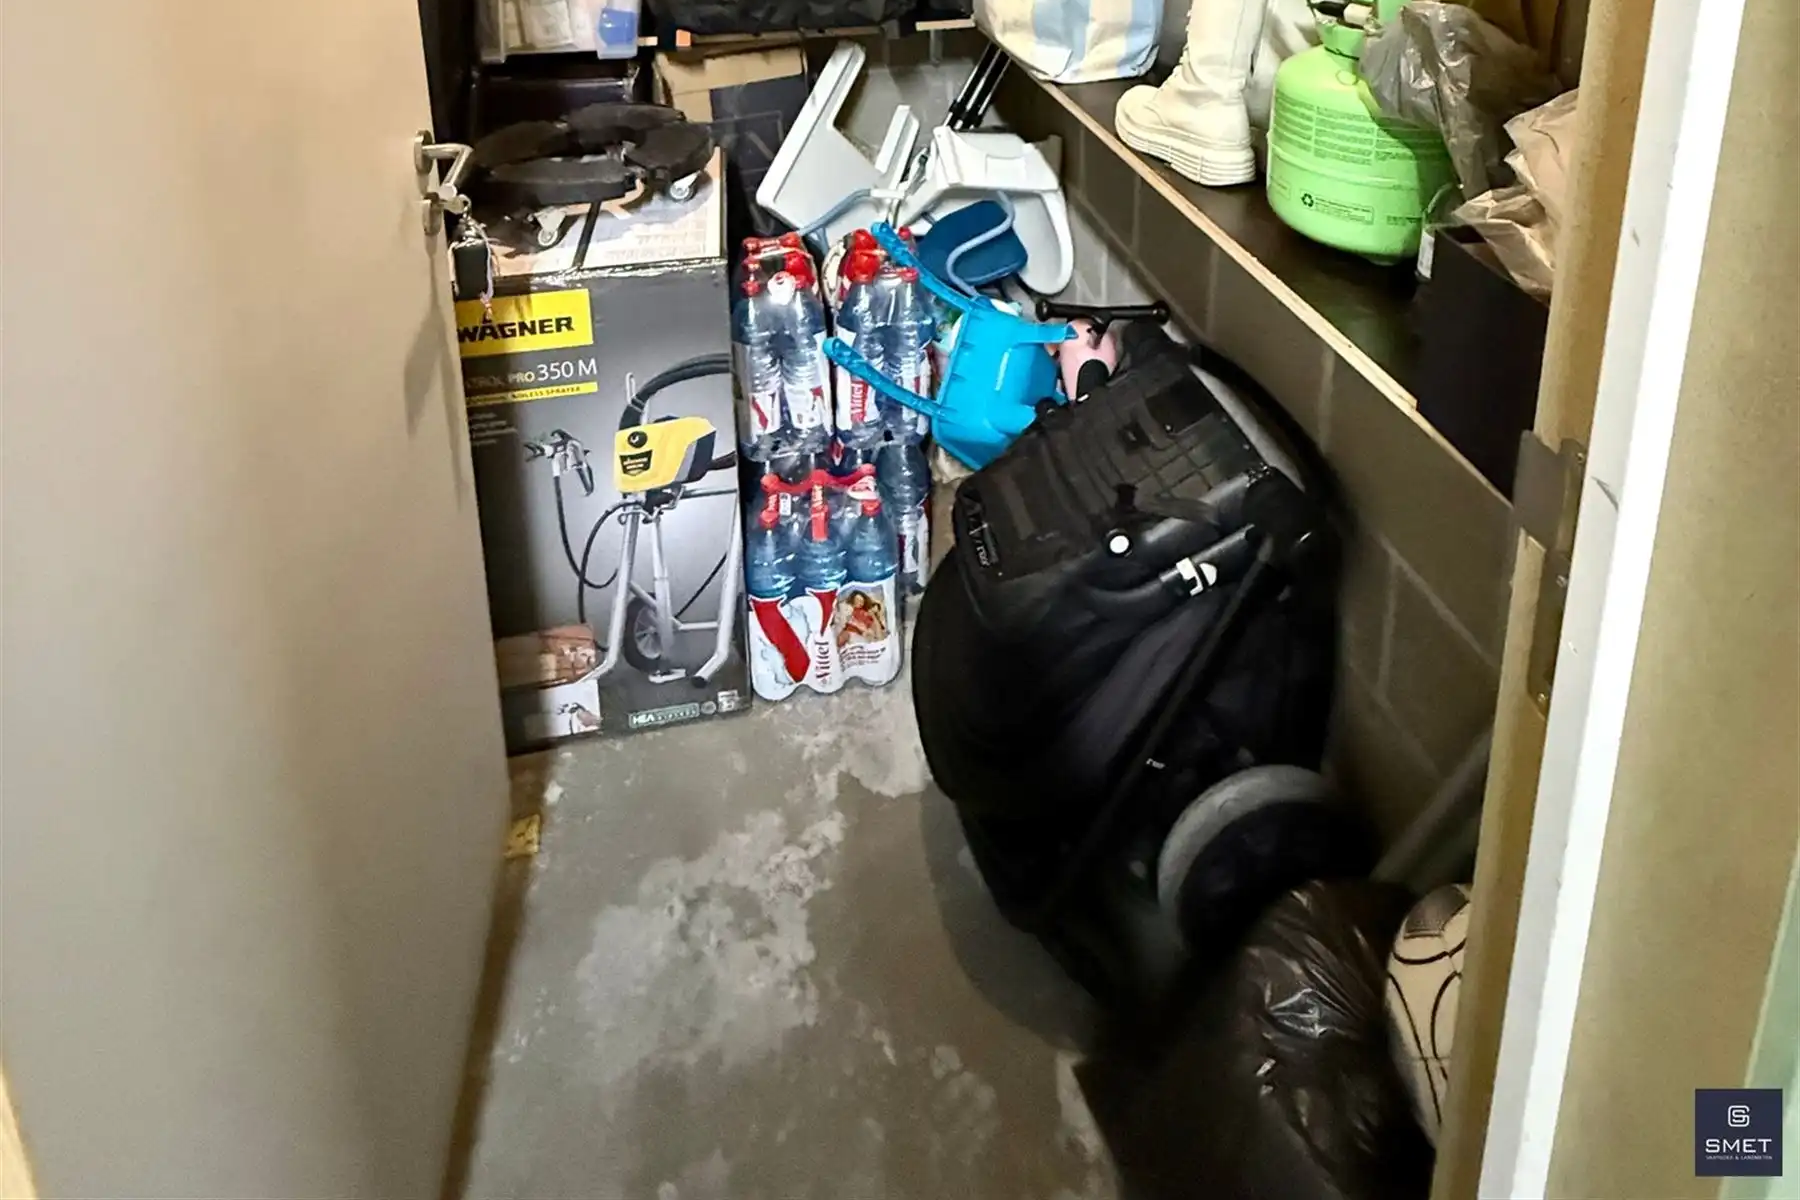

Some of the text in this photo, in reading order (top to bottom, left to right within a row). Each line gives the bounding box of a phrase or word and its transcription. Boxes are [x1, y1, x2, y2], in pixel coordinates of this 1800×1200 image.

[458, 315, 576, 343] WAGNER
[536, 360, 575, 383] 350
[578, 357, 598, 377] M
